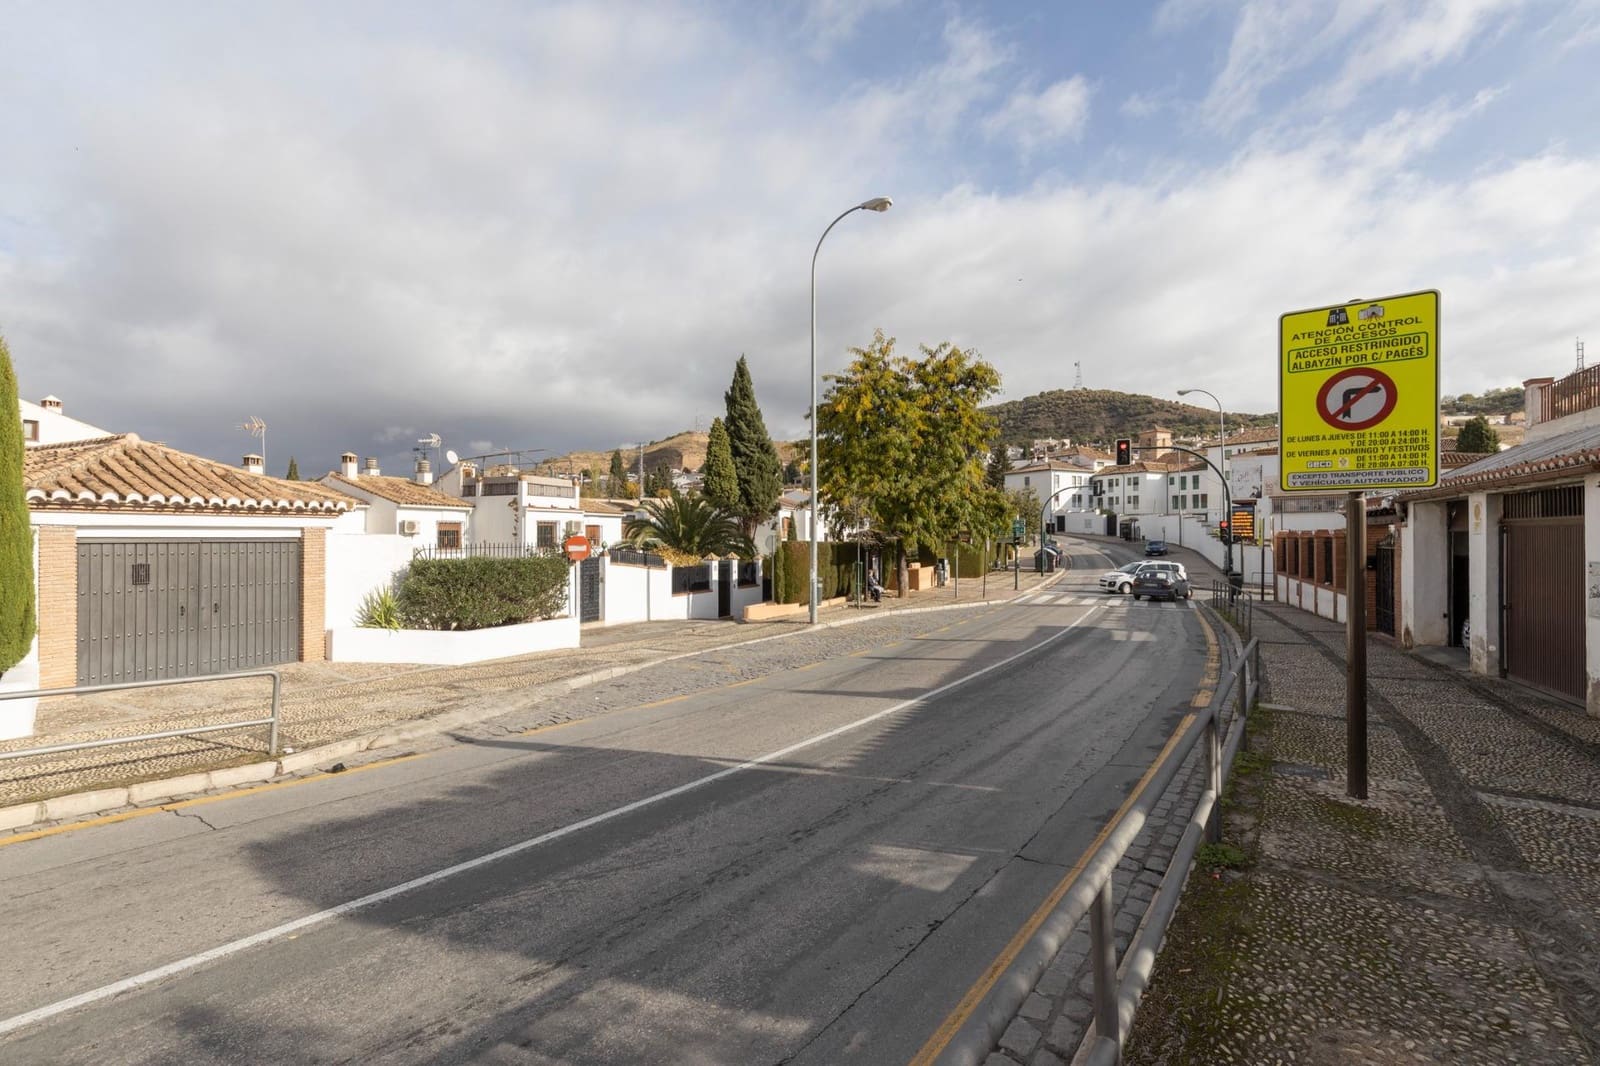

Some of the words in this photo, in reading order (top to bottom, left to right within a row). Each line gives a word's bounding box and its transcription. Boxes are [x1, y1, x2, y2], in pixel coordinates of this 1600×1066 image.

[1292, 326, 1354, 340] ATENCIÓN
[1358, 316, 1422, 331] CONTROL
[1314, 337, 1330, 345] DE
[1334, 328, 1397, 342] ACCESOS
[1296, 346, 1338, 360] ACCESO
[1341, 336, 1420, 353] RESTRINGIDO
[1346, 354, 1368, 364] POR
[1372, 352, 1382, 361] C/
[1340, 447, 1378, 455] DOMINGO
[1388, 444, 1430, 452] FESTIVOS
